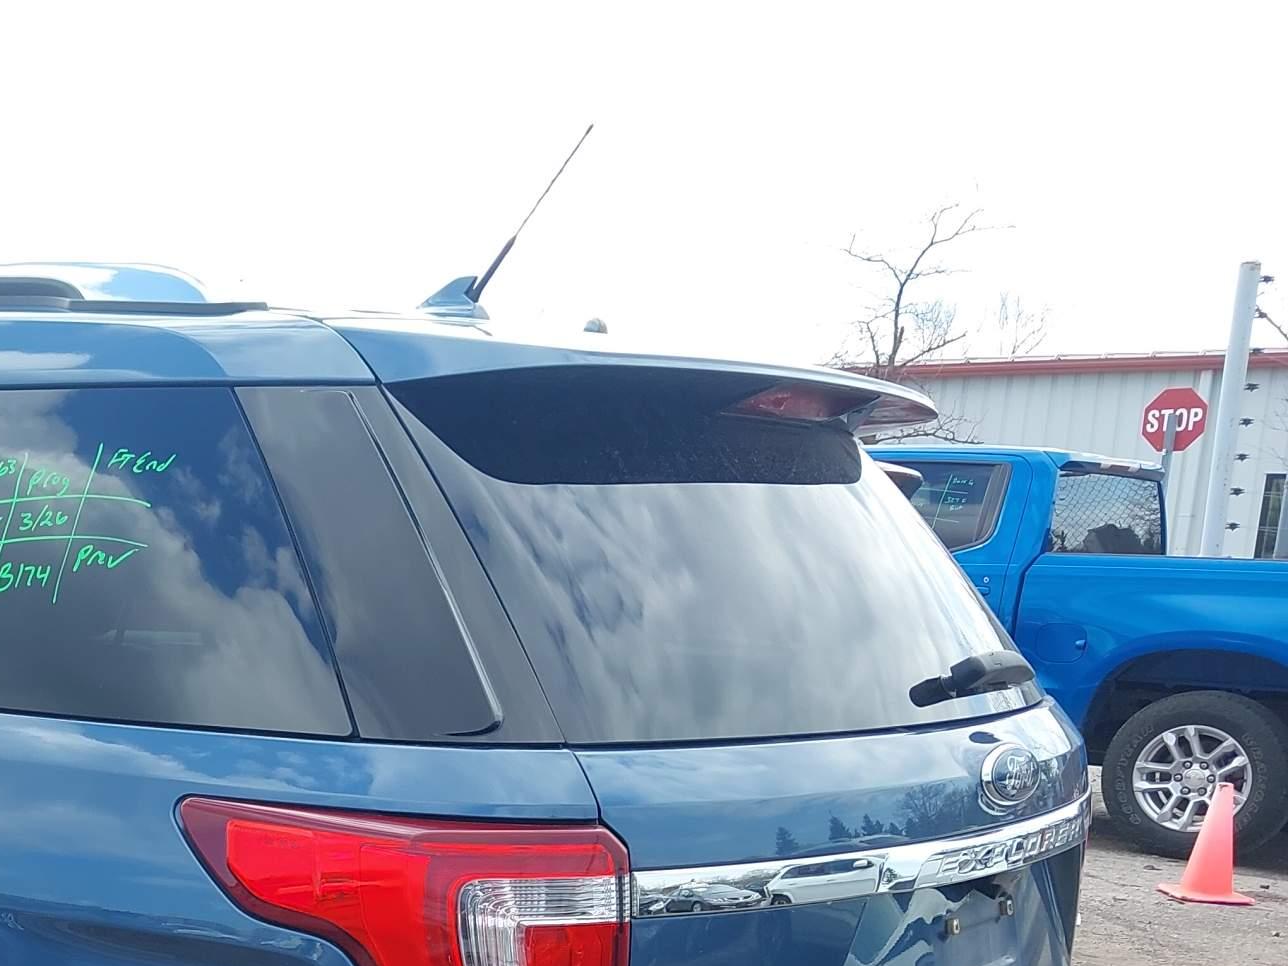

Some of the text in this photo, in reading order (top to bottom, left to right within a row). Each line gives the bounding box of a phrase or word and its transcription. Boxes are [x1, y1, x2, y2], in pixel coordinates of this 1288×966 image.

[1146, 407, 1203, 433] STOP
[18, 504, 68, 532] 3/26
[936, 815, 1083, 878] EXPLORER
